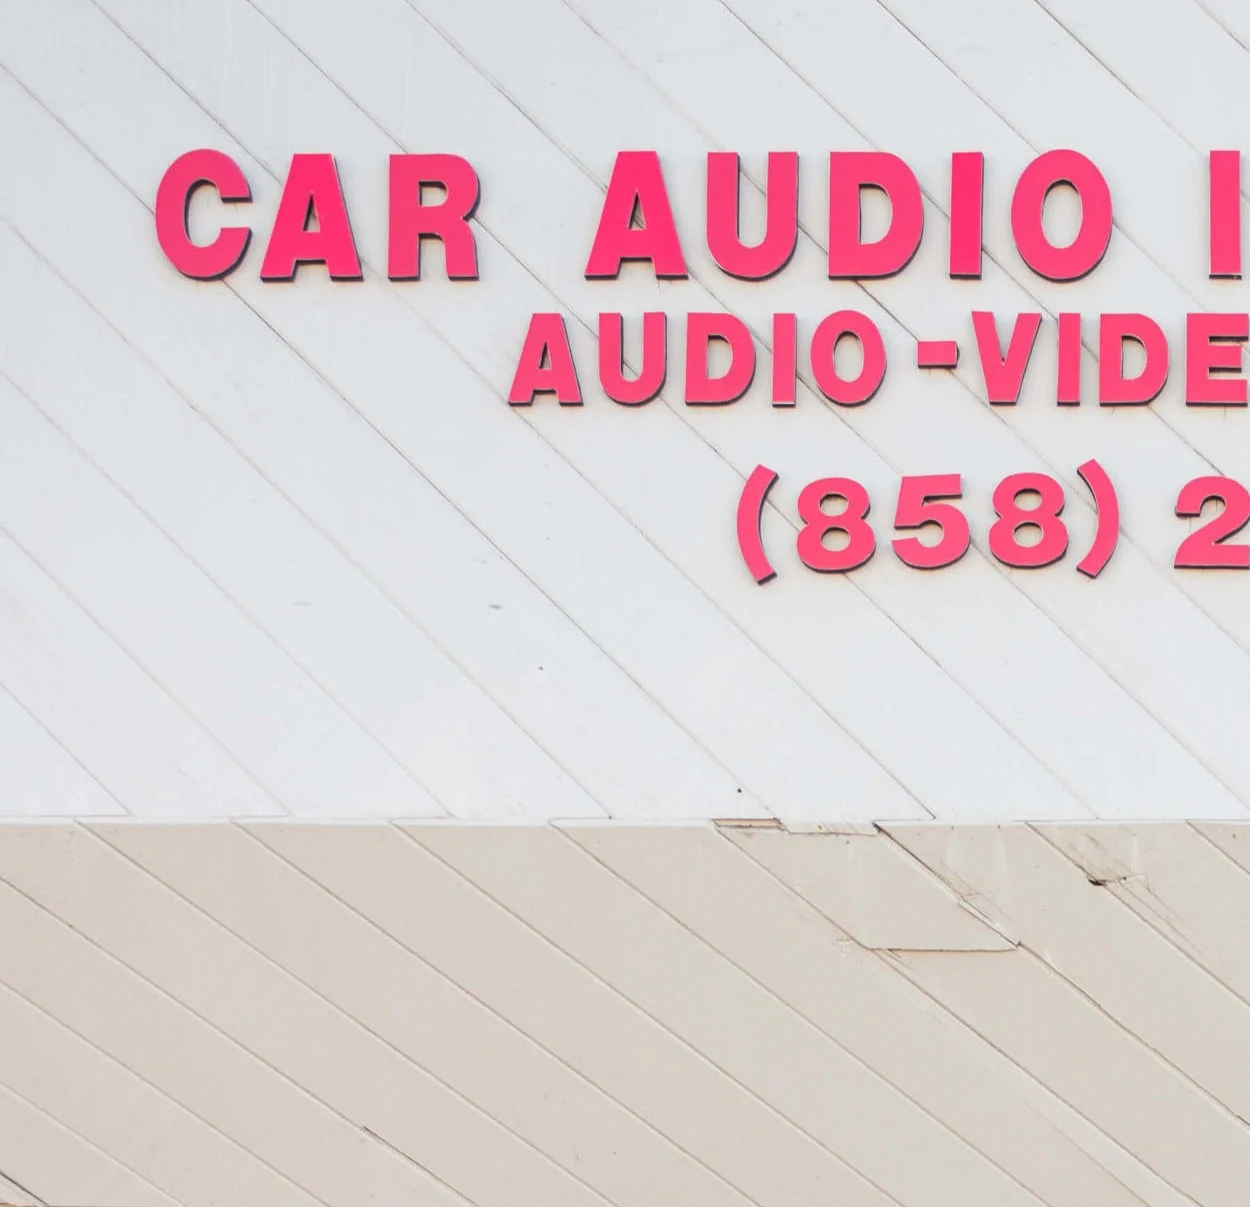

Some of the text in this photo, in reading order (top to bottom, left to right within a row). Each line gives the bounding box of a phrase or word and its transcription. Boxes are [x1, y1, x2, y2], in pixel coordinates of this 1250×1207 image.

[153, 147, 479, 281] CAR
[583, 148, 1113, 282] AUDIO
[735, 458, 1121, 583] (858)
